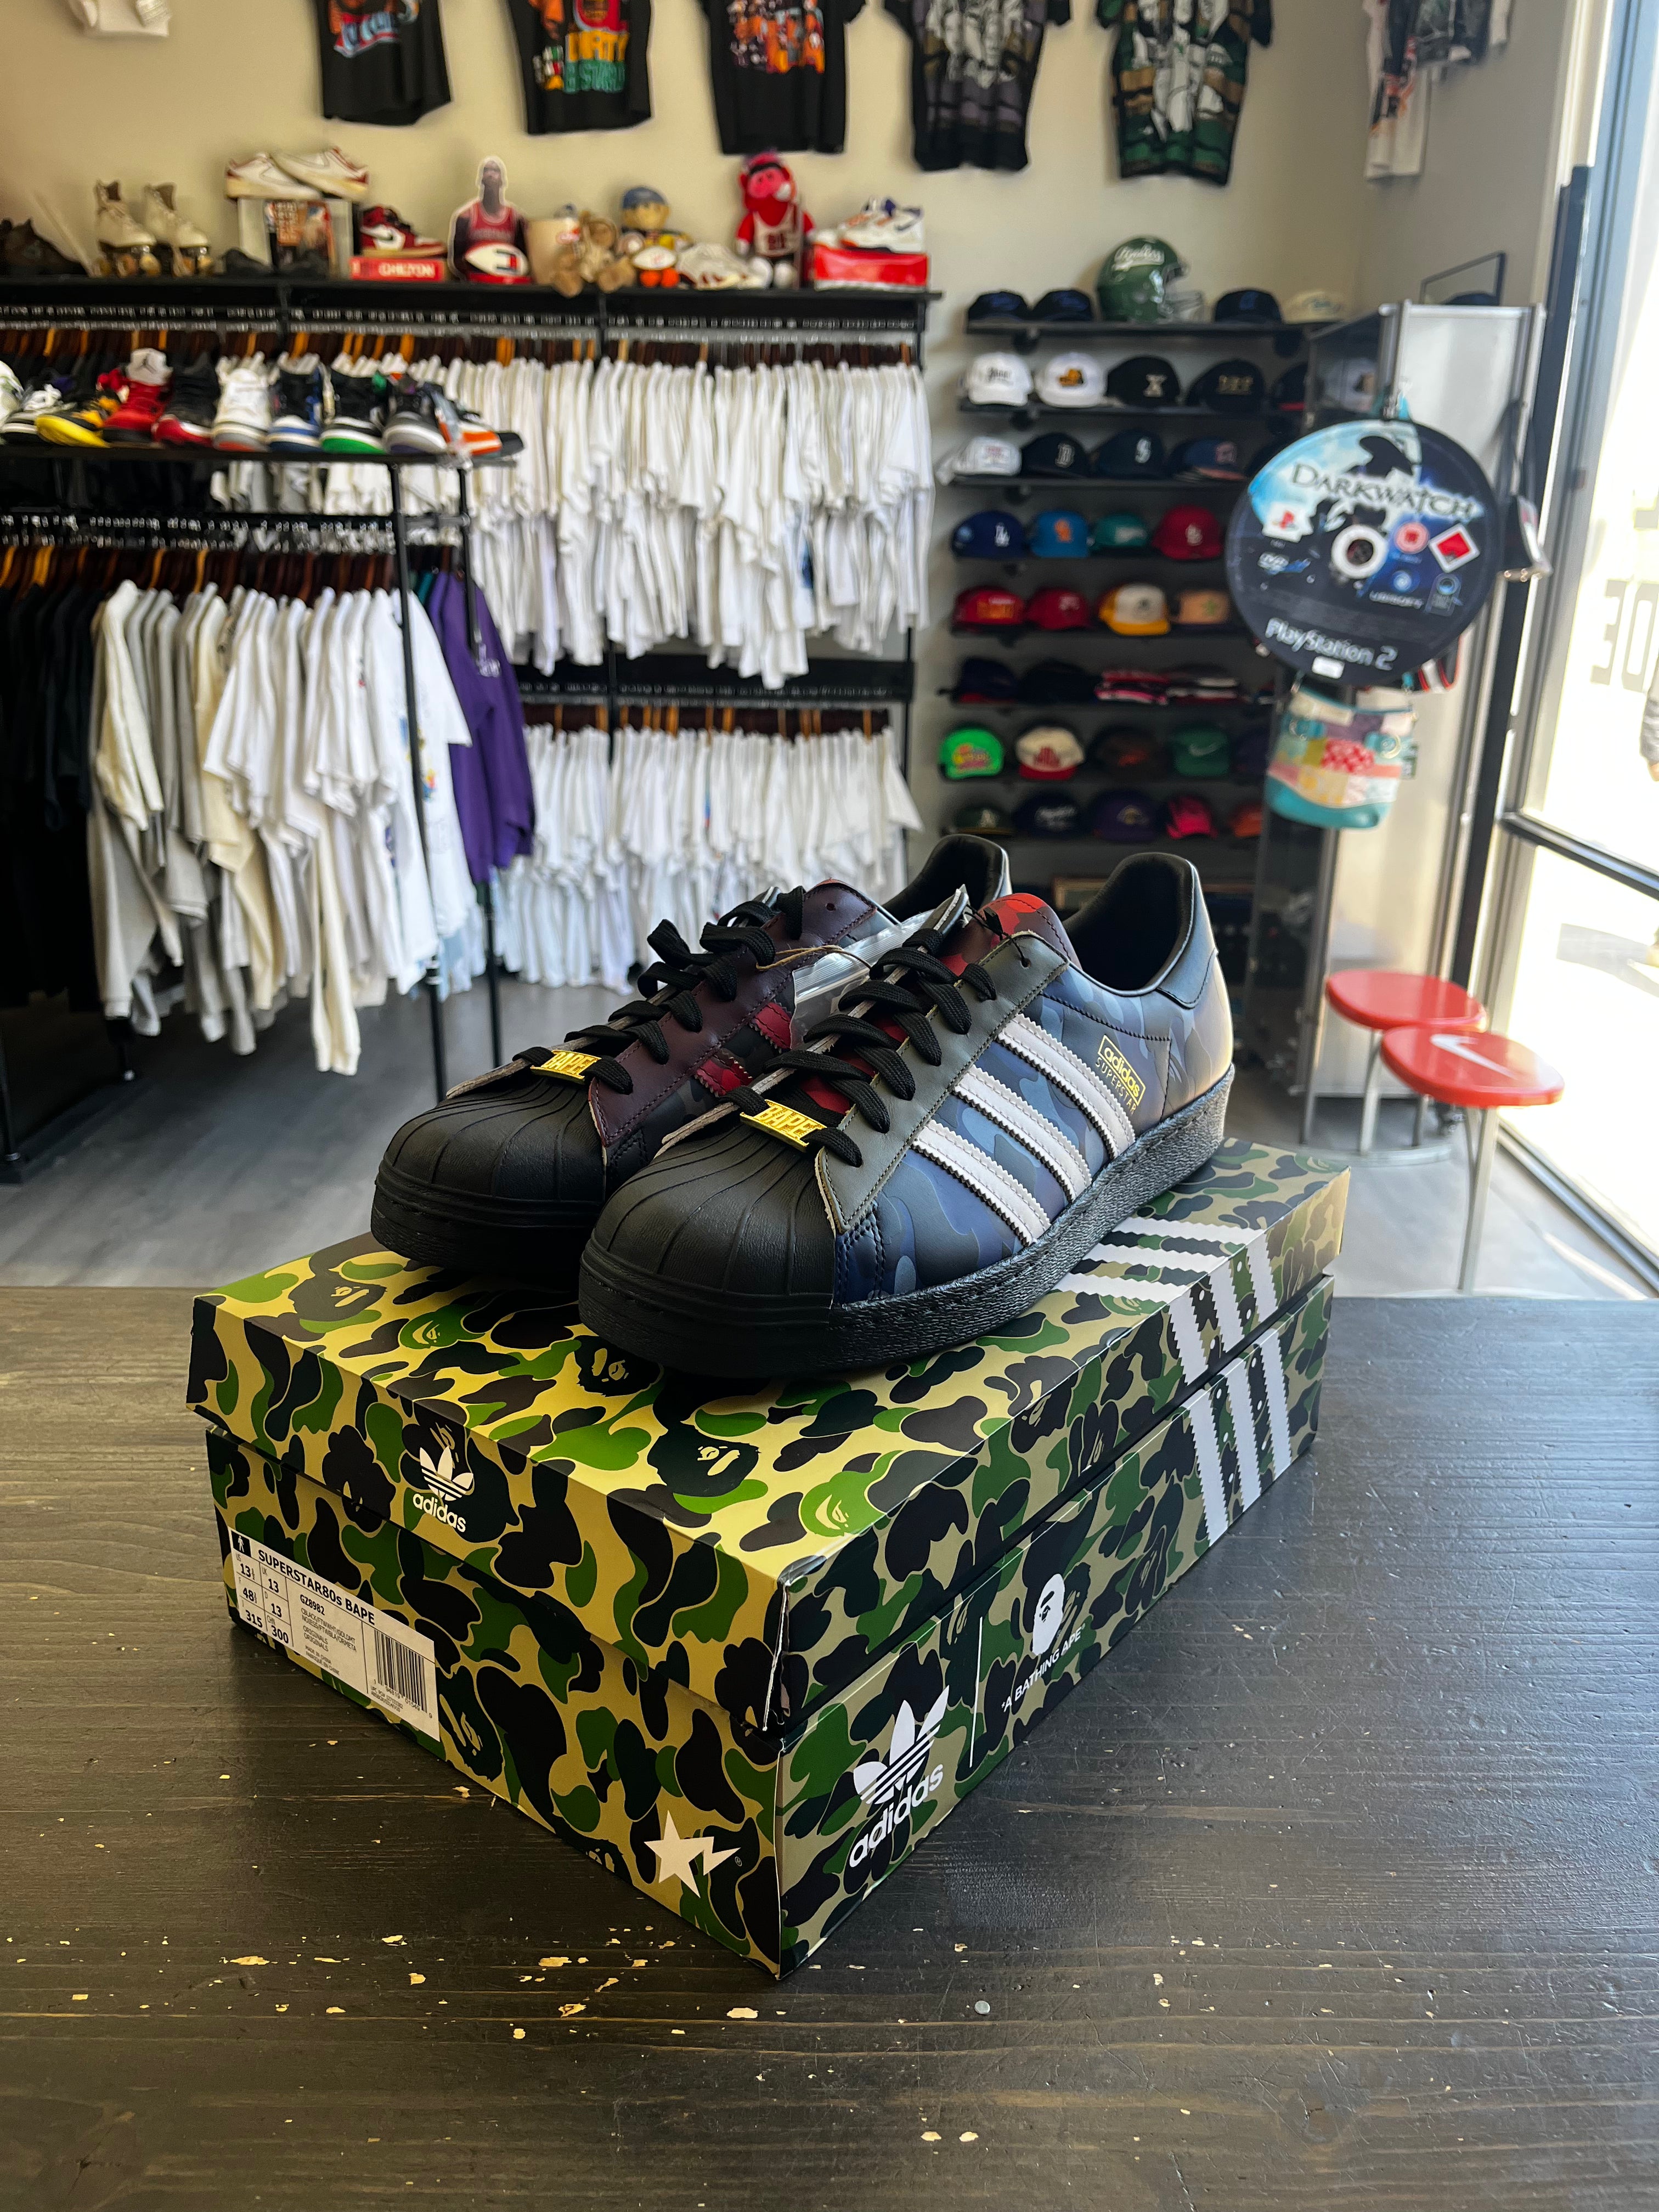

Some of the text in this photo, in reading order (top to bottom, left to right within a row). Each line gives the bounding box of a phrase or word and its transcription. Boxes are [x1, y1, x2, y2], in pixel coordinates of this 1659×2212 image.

[1265, 617, 1397, 670] PlayStation 2
[541, 1052, 594, 1074] BAPE
[1104, 1047, 1139, 1097] adidas
[1096, 1057, 1137, 1115] SUPERSTAR
[753, 1104, 819, 1139] BAPE
[413, 1493, 466, 1532] adidas
[258, 1549, 375, 1626] SUPERSTAR80s BAPE
[268, 1578, 279, 1593] 13
[245, 1610, 263, 1628] 315
[271, 1603, 282, 1618] 13
[300, 1594, 325, 1616] GZ8982
[271, 1625, 289, 1644] 300
[303, 1625, 329, 1645] ORIGINALS
[303, 1632, 329, 1652] ORIGINALS
[1015, 1649, 1060, 1701] BATHING
[849, 1764, 944, 1867] adidas
